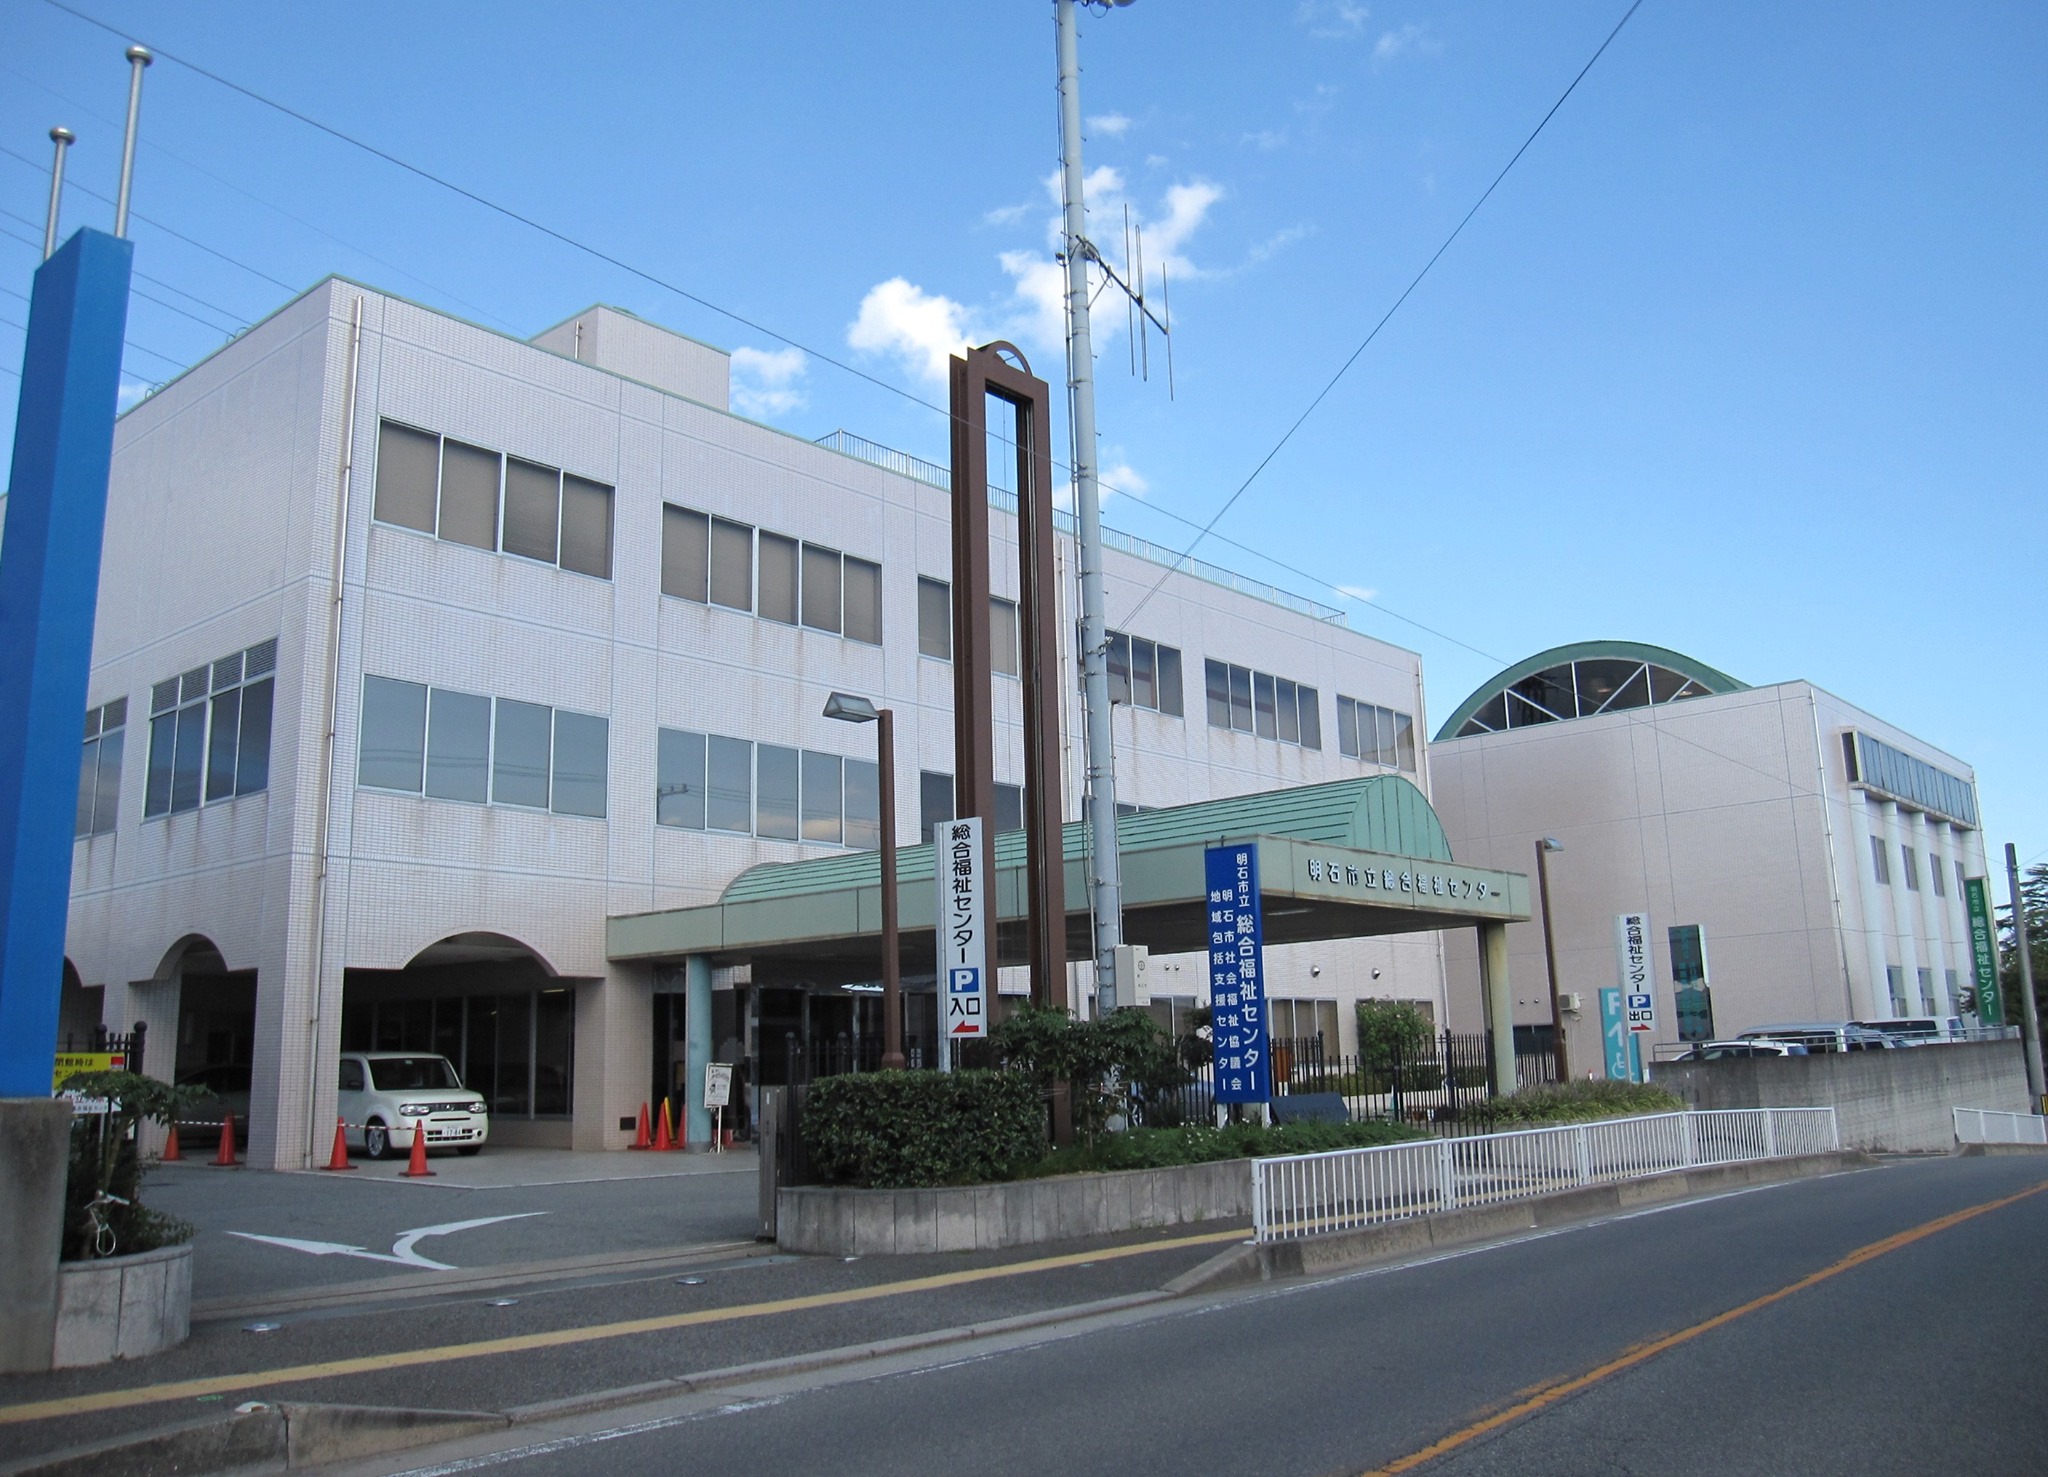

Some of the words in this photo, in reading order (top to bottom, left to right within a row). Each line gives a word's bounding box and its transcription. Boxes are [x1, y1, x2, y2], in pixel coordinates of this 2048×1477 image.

[951, 824, 973, 964] 総合福祉センター
[1236, 853, 1250, 908] 明石市立
[1308, 858, 1501, 900] 明石市立総合福祉センター
[954, 970, 974, 991] P
[1626, 915, 1645, 993] 総合福祉センター
[1972, 916, 1995, 1016] 総合福祉センター
[950, 998, 981, 1016] 入口
[1210, 891, 1229, 1091] 地域包括支援センター
[1222, 889, 1243, 1091] 明石市社会福祉協議会
[1236, 914, 1259, 1091] 総合福祉センター
[1629, 1010, 1653, 1022] 出口
[1632, 996, 1647, 1008] P
